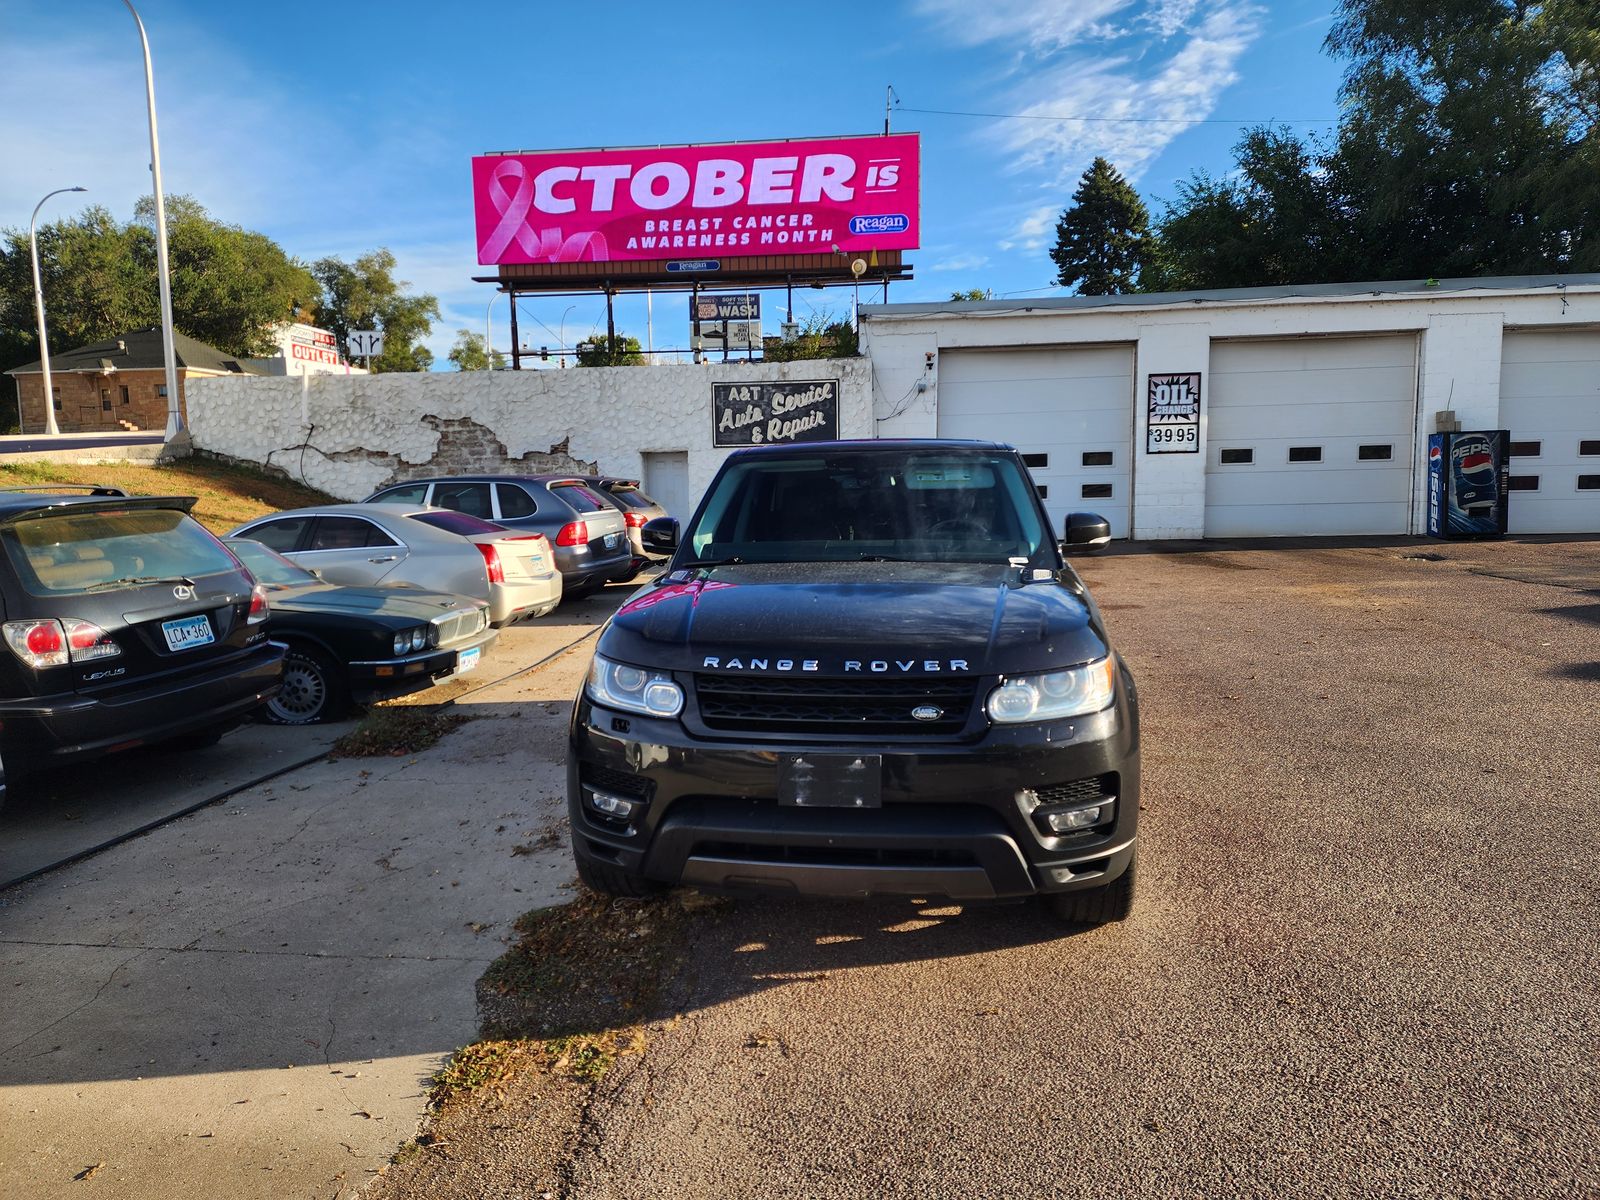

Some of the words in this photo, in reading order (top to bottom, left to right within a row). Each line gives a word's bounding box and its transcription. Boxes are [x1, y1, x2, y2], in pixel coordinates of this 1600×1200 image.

[865, 165, 899, 187] IS
[644, 217, 723, 233] BREAST
[733, 213, 814, 229] CANCER
[855, 216, 904, 233] Reagan
[626, 232, 750, 249] AWARENESS
[760, 229, 833, 244] MONTH
[679, 261, 707, 271] Reagan
[718, 305, 758, 317] WASH
[293, 345, 336, 364] OUTLET
[728, 386, 761, 401] A&T
[1155, 384, 1194, 406] OIL
[719, 404, 764, 433] Auto
[771, 383, 833, 415] Service
[1156, 405, 1194, 415] CHANGE
[751, 426, 764, 443] &
[766, 410, 826, 441] Repair
[1431, 471, 1439, 533] PEPSI
[166, 627, 188, 644] LCA
[191, 623, 210, 639] 360
[703, 656, 819, 672] RANGE
[844, 659, 969, 672] ROVER
[83, 667, 126, 681] LEXUS
